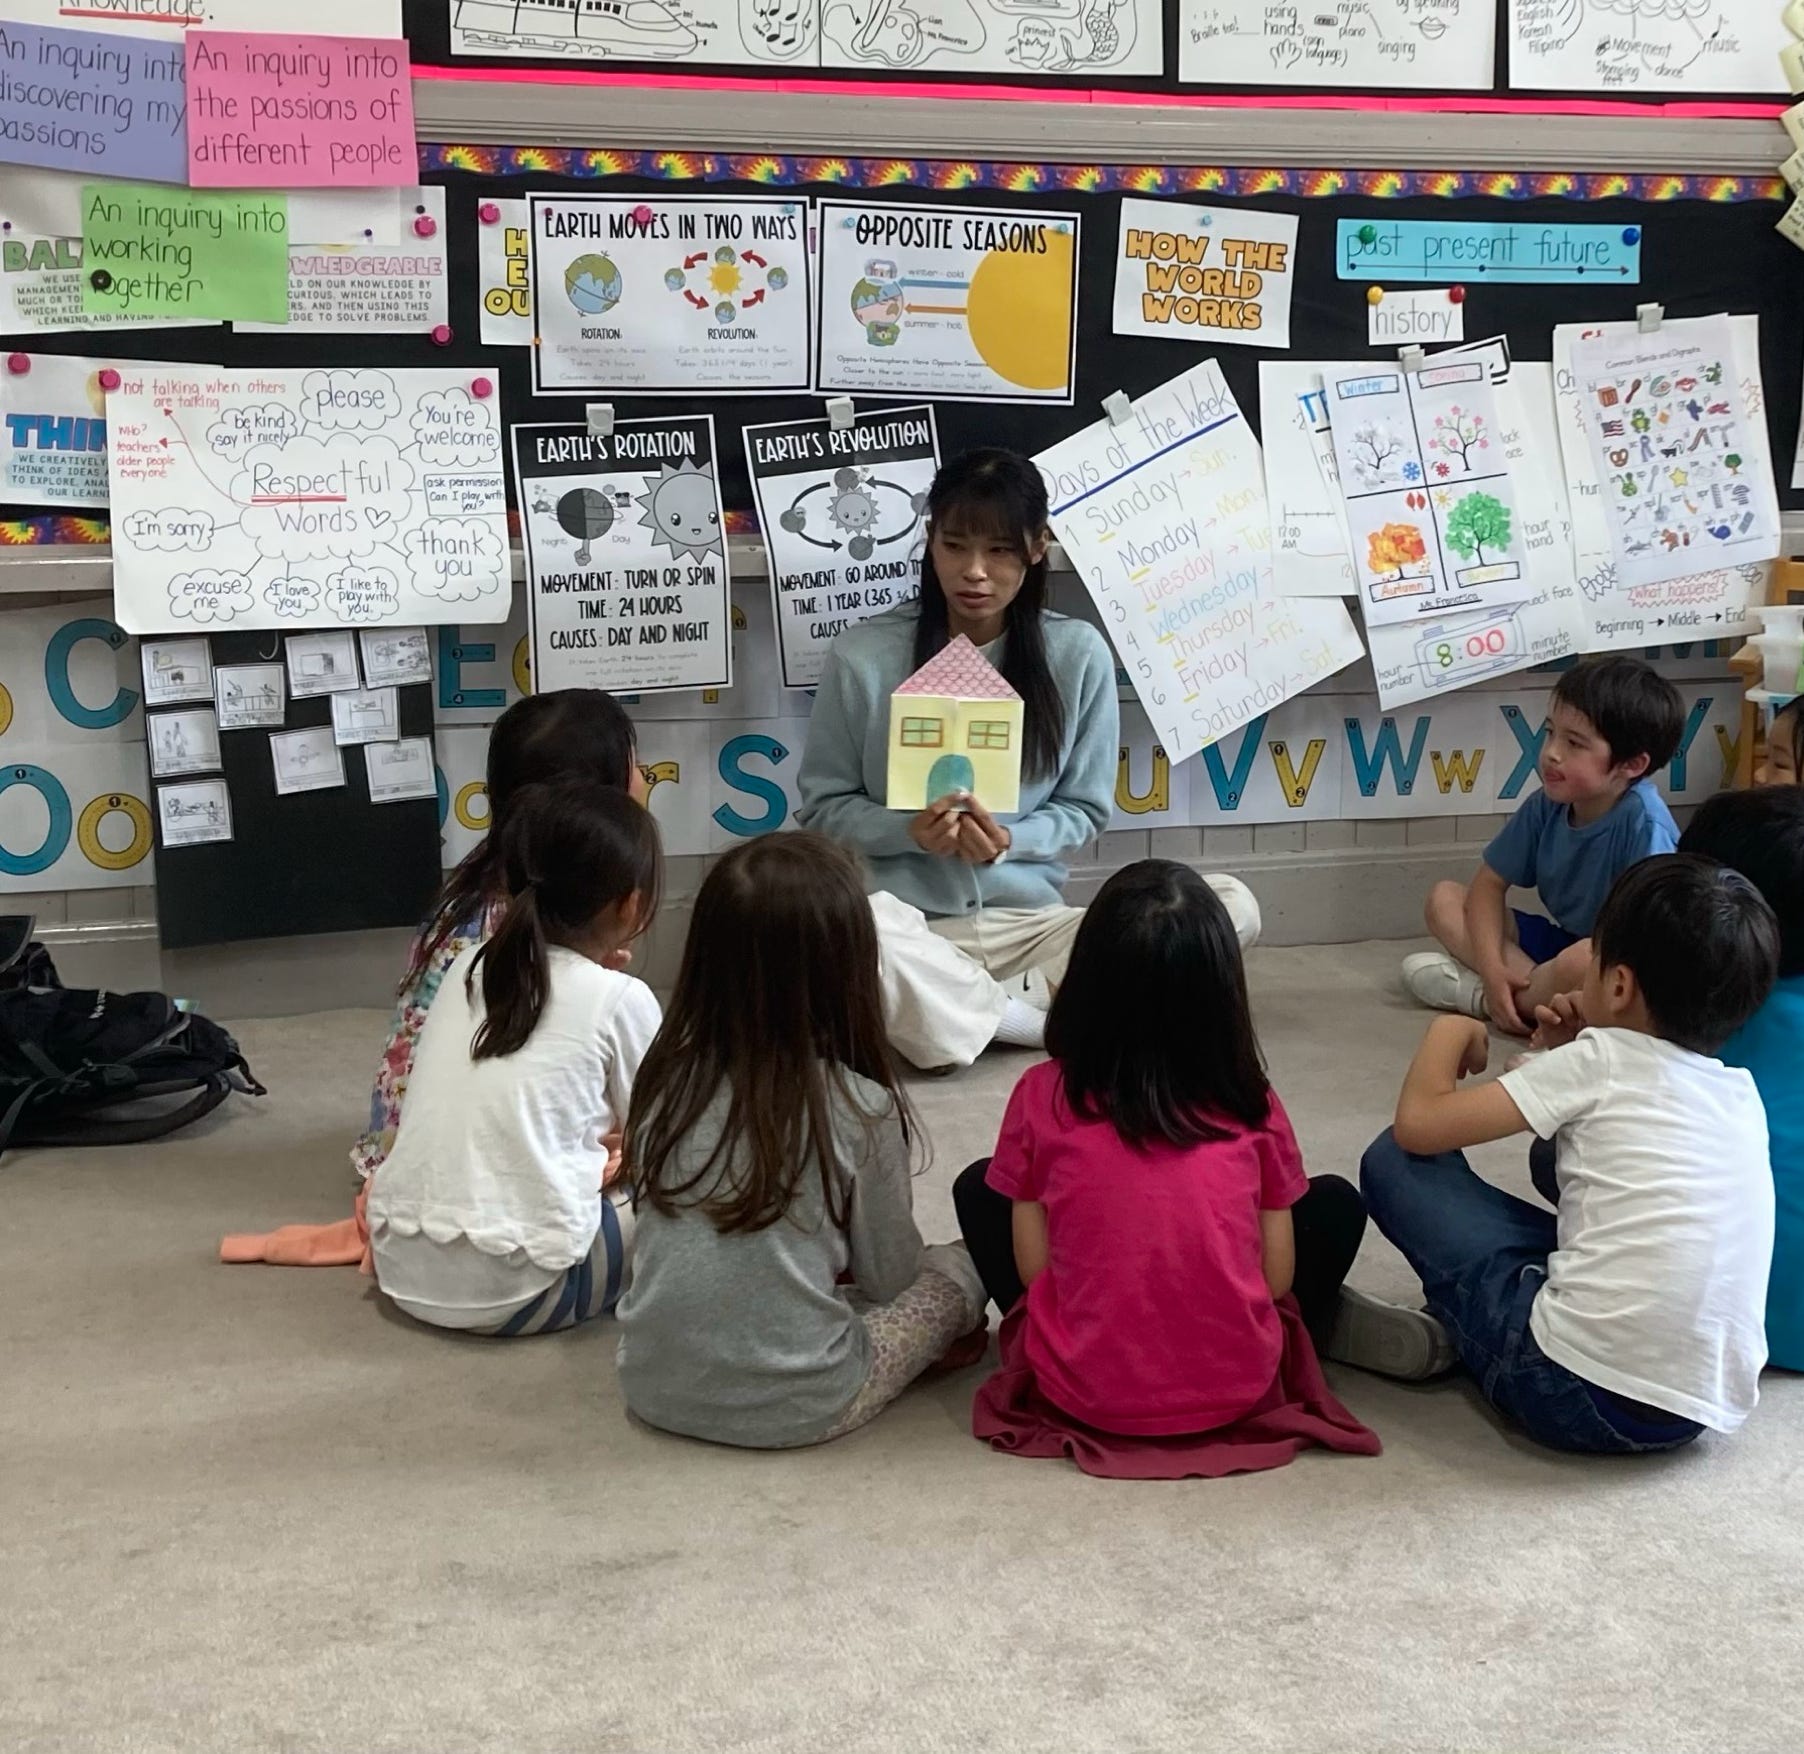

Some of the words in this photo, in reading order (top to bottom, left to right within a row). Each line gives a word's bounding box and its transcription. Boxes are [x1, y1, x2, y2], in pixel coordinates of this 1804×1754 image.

[1264, 19, 1304, 36] hands
[1700, 36, 1741, 53] music
[39, 37, 130, 85] inquiry
[193, 40, 228, 72] An
[245, 45, 331, 88] inquiry
[345, 48, 398, 79] into
[147, 99, 187, 137] my
[196, 87, 238, 119] the
[251, 92, 357, 131] passions
[370, 89, 401, 122] of
[195, 134, 312, 167] different
[330, 140, 402, 175] people
[89, 195, 122, 222] An
[137, 198, 224, 238] inquiry
[237, 201, 285, 233] into
[546, 213, 600, 238] EARTH
[679, 214, 696, 239] IN
[706, 215, 743, 239] TWO
[752, 214, 797, 240] WAYS
[855, 213, 953, 249] OPPOSITE
[963, 220, 1048, 254] SEASONS
[90, 238, 192, 279] working
[1126, 230, 1209, 265] HOW
[1221, 239, 1288, 274] THE
[1347, 229, 1403, 271] past
[1423, 233, 1520, 277] present
[1531, 230, 1610, 264] future
[308, 280, 321, 288] ON
[327, 280, 345, 288] OUR
[350, 280, 414, 288] KNOWLEDGE
[418, 280, 431, 288] BY
[1146, 264, 1262, 298] WORLD
[18, 297, 45, 305] MUCH
[312, 302, 332, 310] AND
[338, 302, 363, 310] THEN
[368, 302, 399, 310] USING
[405, 302, 429, 310] THIS
[341, 291, 376, 299] WHICH
[381, 291, 413, 299] LEADS
[418, 291, 432, 299] TO
[23, 306, 57, 315] WHICH
[320, 313, 332, 321] TO
[337, 313, 369, 321] SOLVE
[1142, 293, 1262, 330] WORKS
[1374, 302, 1453, 339] history
[124, 380, 143, 395] not
[152, 379, 200, 395] talking
[206, 379, 240, 393] when
[248, 380, 286, 393] others
[316, 379, 385, 416] please
[154, 398, 172, 408] are
[426, 404, 475, 426] You're
[235, 414, 251, 428] be
[255, 413, 285, 428] kind
[1106, 425, 1132, 470] of
[1139, 405, 1182, 449] the
[1177, 371, 1238, 430] Week
[215, 434, 238, 448] say
[243, 430, 253, 442] it
[257, 431, 290, 447] nicely
[425, 426, 495, 447] welcome
[537, 435, 608, 463] EARTH'S
[615, 431, 696, 459] ROTATION
[755, 432, 824, 463] EARTH'S
[828, 420, 929, 454] REVOLUTION
[13, 465, 44, 473] THINK
[68, 468, 99, 476] IDEAS
[19, 455, 34, 463] WE
[40, 456, 105, 466] CREATIVELY
[146, 455, 175, 470] people
[13, 475, 25, 484] TO
[252, 459, 390, 507] Respectful
[427, 479, 446, 488] ask
[449, 479, 502, 489] permission
[47, 488, 67, 496] OUR
[430, 491, 447, 501] Can
[462, 491, 480, 504] play
[274, 506, 358, 535] Words
[1066, 524, 1081, 547] 1
[1085, 471, 1184, 535] Sunday
[134, 521, 162, 536] I'm
[167, 522, 205, 544] sorry
[416, 529, 486, 555] thank
[1526, 533, 1554, 550] hand
[1091, 567, 1110, 593] 2
[1117, 516, 1202, 577] Monday
[336, 578, 344, 590] I
[350, 576, 371, 590] like
[374, 577, 387, 590] to
[434, 560, 472, 589] you
[625, 570, 657, 590] TURN
[663, 568, 681, 587] OR
[688, 566, 715, 585] SPIN
[845, 565, 860, 585] GO
[864, 560, 907, 582] AROUND
[183, 579, 242, 595] excuse
[273, 583, 281, 595] I
[285, 582, 310, 595] love
[339, 590, 361, 603] play
[366, 589, 392, 602] with
[1109, 600, 1127, 624] 3
[1133, 549, 1218, 607] Tuesday
[194, 596, 218, 609] me
[279, 596, 301, 610] you
[619, 598, 634, 617] 24
[640, 595, 682, 615] HOURS
[834, 592, 861, 611] YEAR
[865, 588, 892, 607] (365
[1127, 635, 1140, 652] 4
[1150, 565, 1259, 643] Wednesday
[608, 628, 632, 646] DAY
[639, 625, 667, 643] AND
[673, 622, 709, 642] NIGHT
[1595, 617, 1644, 638] Beginning
[1668, 612, 1701, 627] Middle
[1725, 606, 1746, 624] End
[1137, 657, 1152, 679] 5
[1164, 600, 1257, 665] Thursday
[1531, 629, 1570, 651] minute
[45, 618, 139, 729] C
[1152, 685, 1167, 706] 6
[1177, 642, 1249, 697] Friday
[1378, 664, 1402, 680] hour
[1167, 728, 1182, 752] 7
[1191, 669, 1287, 740] Saturday
[1344, 716, 1431, 797] W
[712, 734, 789, 837] S
